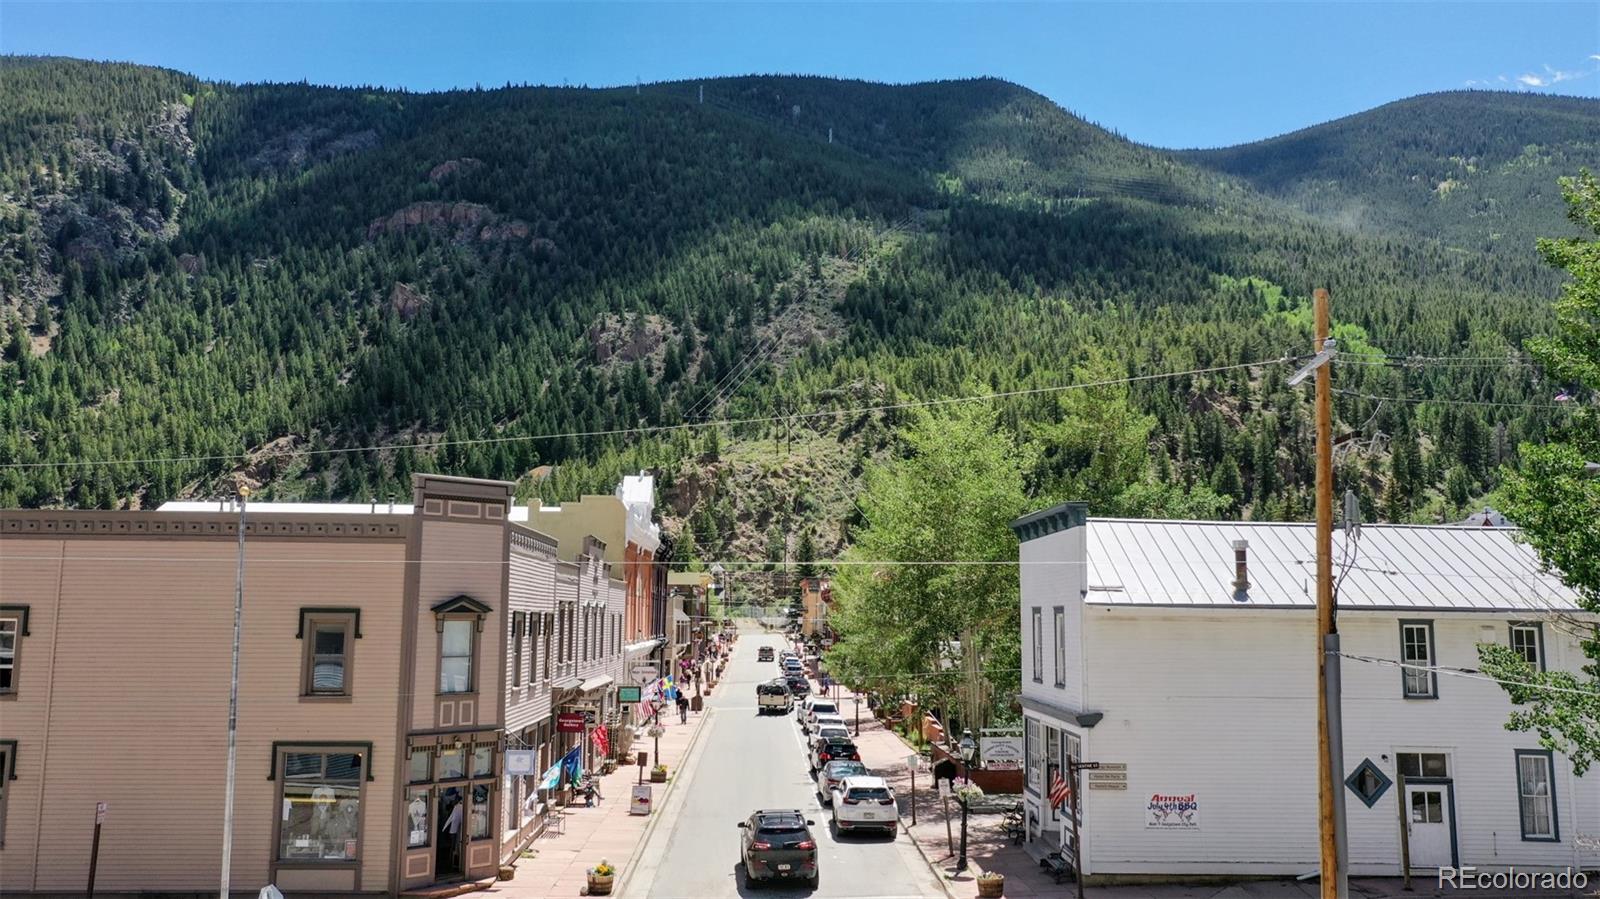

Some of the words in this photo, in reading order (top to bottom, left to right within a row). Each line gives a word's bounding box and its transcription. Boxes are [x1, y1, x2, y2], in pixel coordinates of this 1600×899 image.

[1151, 794, 1195, 802] Annual
[1147, 802, 1163, 811] July
[1164, 802, 1177, 811] 4th
[1178, 801, 1198, 811] BBQ
